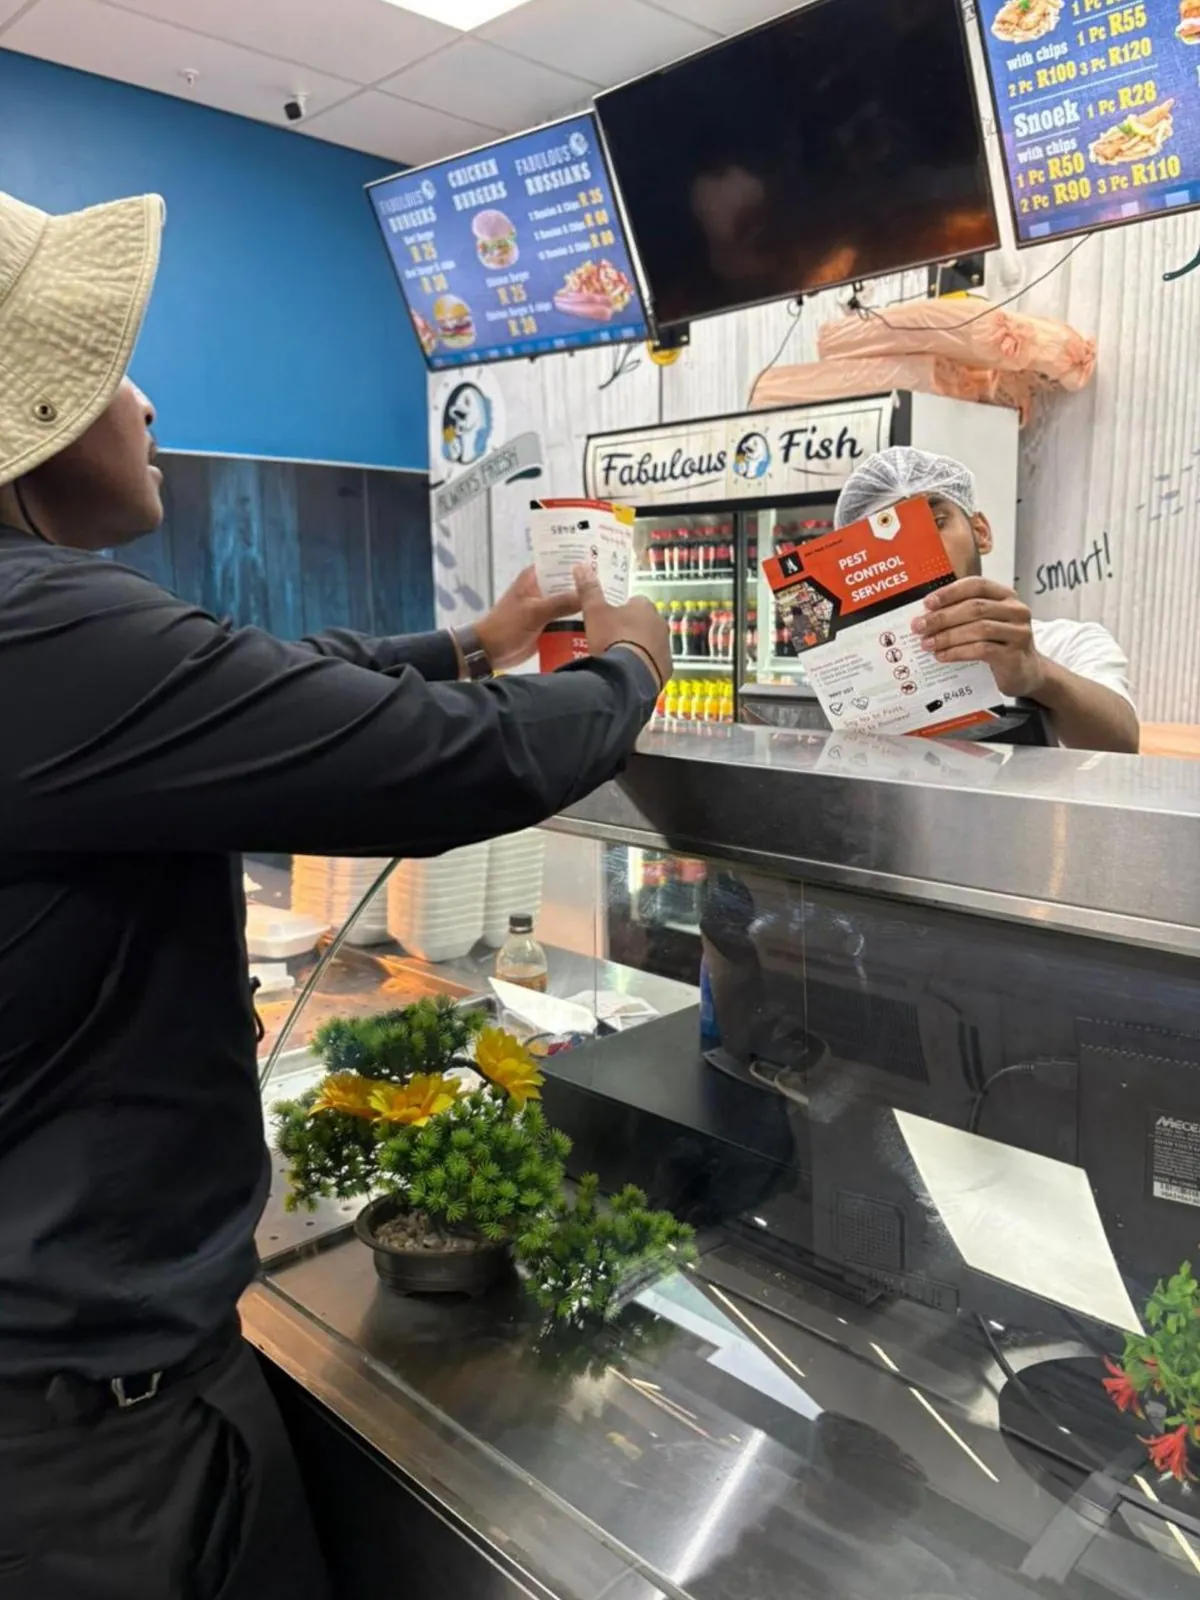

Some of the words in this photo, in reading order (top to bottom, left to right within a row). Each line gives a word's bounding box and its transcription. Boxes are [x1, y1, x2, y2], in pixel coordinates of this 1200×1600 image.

[1006, 51, 1034, 71] with
[1036, 41, 1068, 62] chips
[1077, 30, 1085, 47] 1
[1088, 26, 1107, 43] Pc
[1108, 4, 1147, 36] R55
[1008, 83, 1017, 98] 2
[1018, 80, 1034, 94] Pc
[1036, 60, 1077, 88] R100
[1080, 62, 1089, 76] 3
[1090, 58, 1107, 73] Pc
[1108, 37, 1152, 67] R120
[1013, 98, 1080, 138] Snoek
[1087, 103, 1095, 119] 1
[1098, 99, 1115, 116] Pc
[1118, 79, 1157, 109] R28
[515, 143, 572, 176] FABULOUS
[1017, 146, 1044, 164] with
[1045, 138, 1077, 156] chips
[447, 157, 499, 188] CHICKEN
[525, 161, 592, 196] RUSSIANS
[1017, 173, 1025, 188] 1
[1028, 169, 1045, 185] Pc
[1047, 152, 1085, 180] R50
[1020, 198, 1030, 213] 2
[1032, 194, 1049, 210] Pc
[1053, 177, 1092, 205] R90
[1098, 178, 1107, 195] 3
[1110, 175, 1129, 192] Pc
[1131, 155, 1181, 186] R110
[601, 448, 727, 487] Fabulous
[779, 425, 863, 464] Fish
[838, 549, 868, 570] PEST
[845, 555, 905, 586] CONTROL
[1034, 532, 1113, 595] smart!
[851, 571, 909, 602] SERVICES
[943, 686, 973, 702] R485
